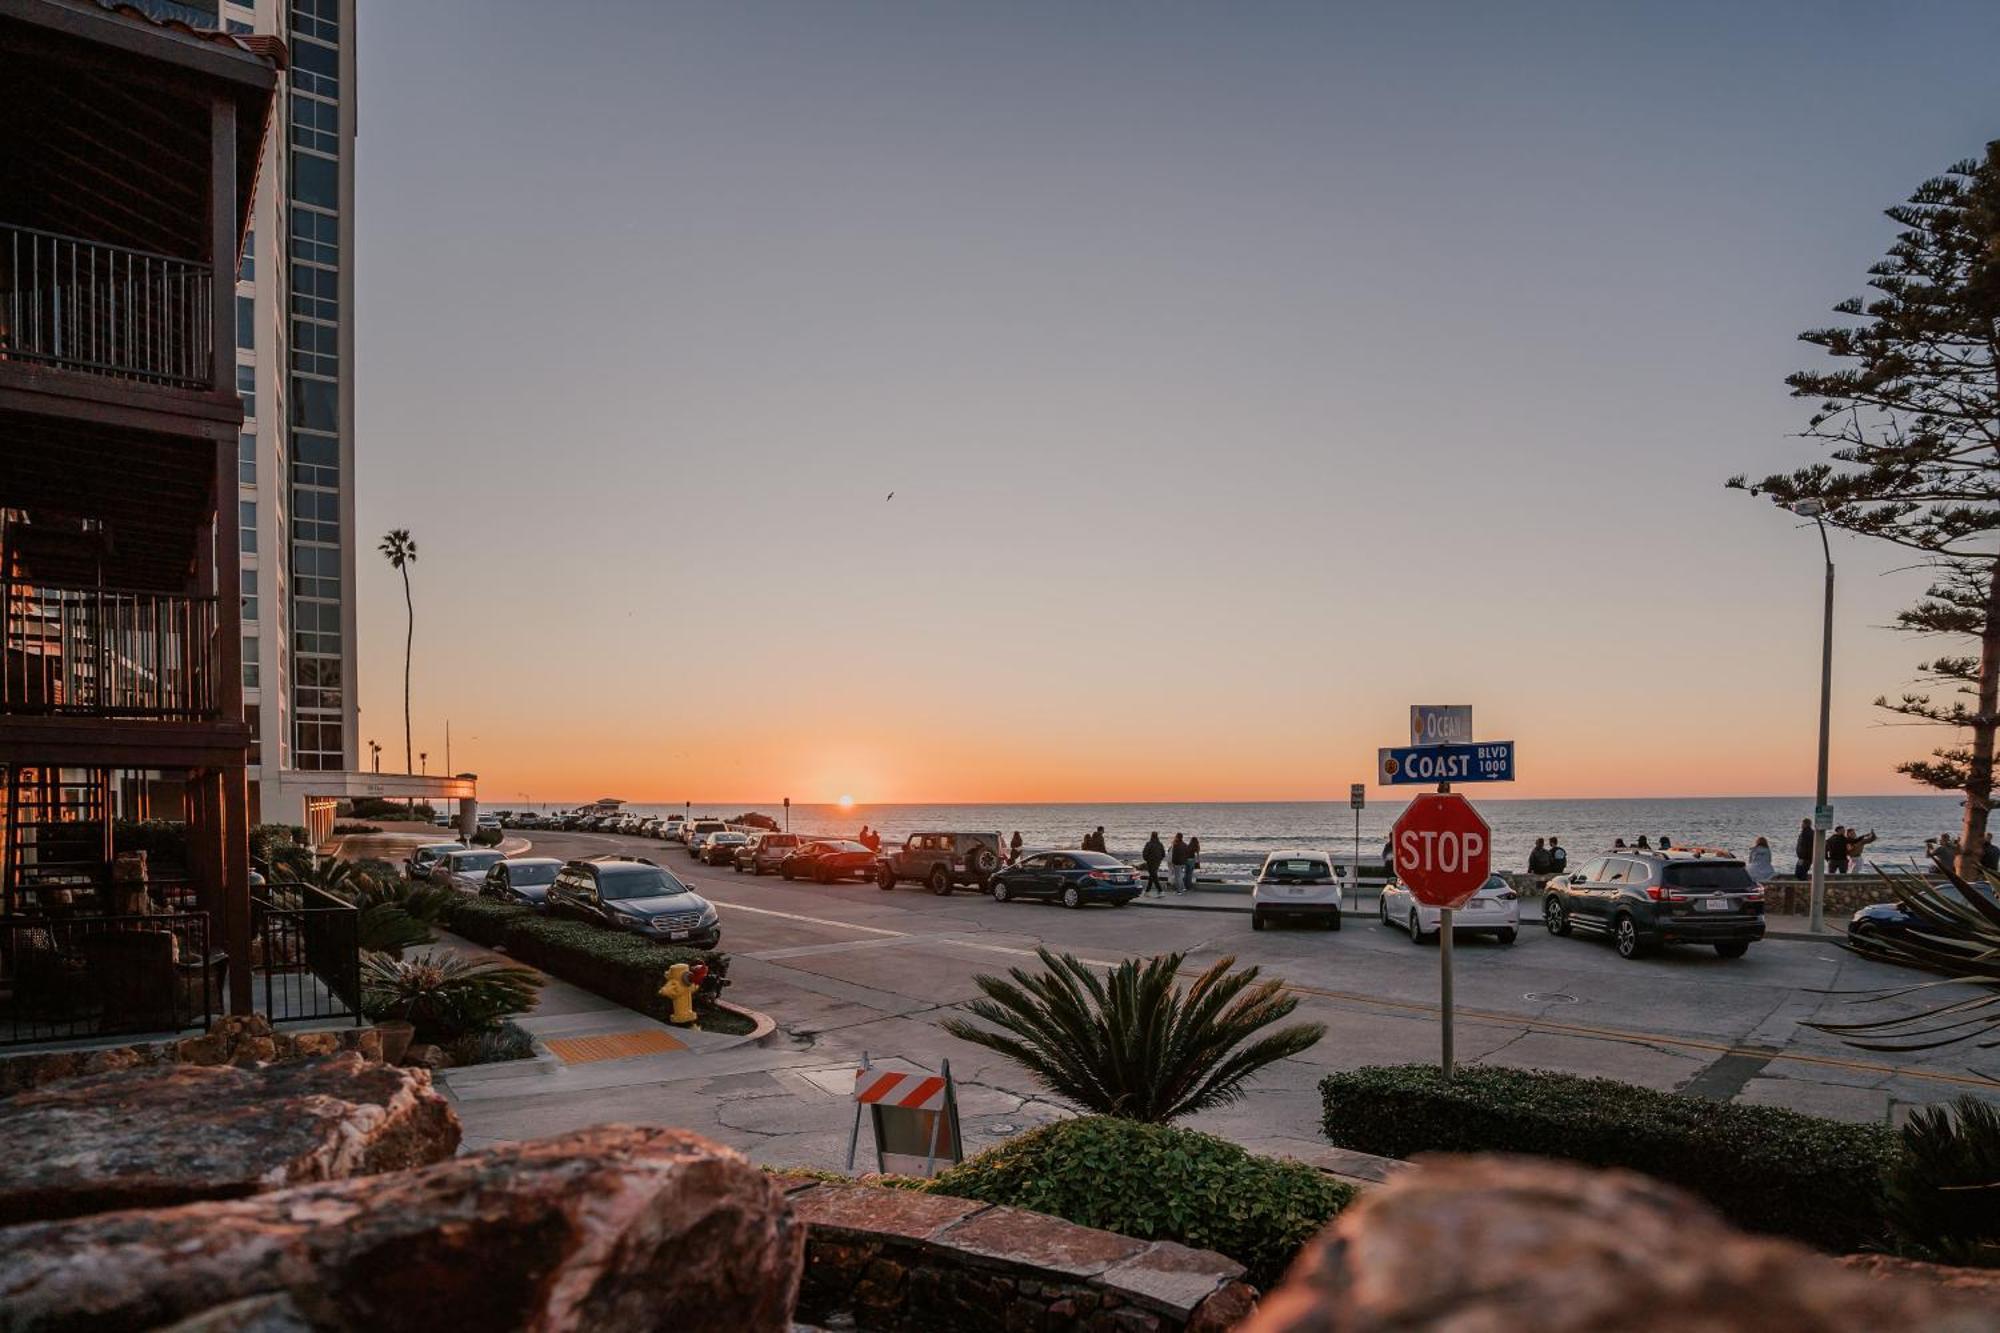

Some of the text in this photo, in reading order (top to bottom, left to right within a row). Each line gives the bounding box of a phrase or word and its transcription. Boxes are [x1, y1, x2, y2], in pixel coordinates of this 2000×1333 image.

[1427, 712, 1461, 738] OCEAN
[1478, 746, 1508, 759] BLVD
[1404, 753, 1471, 778] COAST
[1479, 760, 1507, 772] 1000
[1400, 830, 1484, 873] STOP
